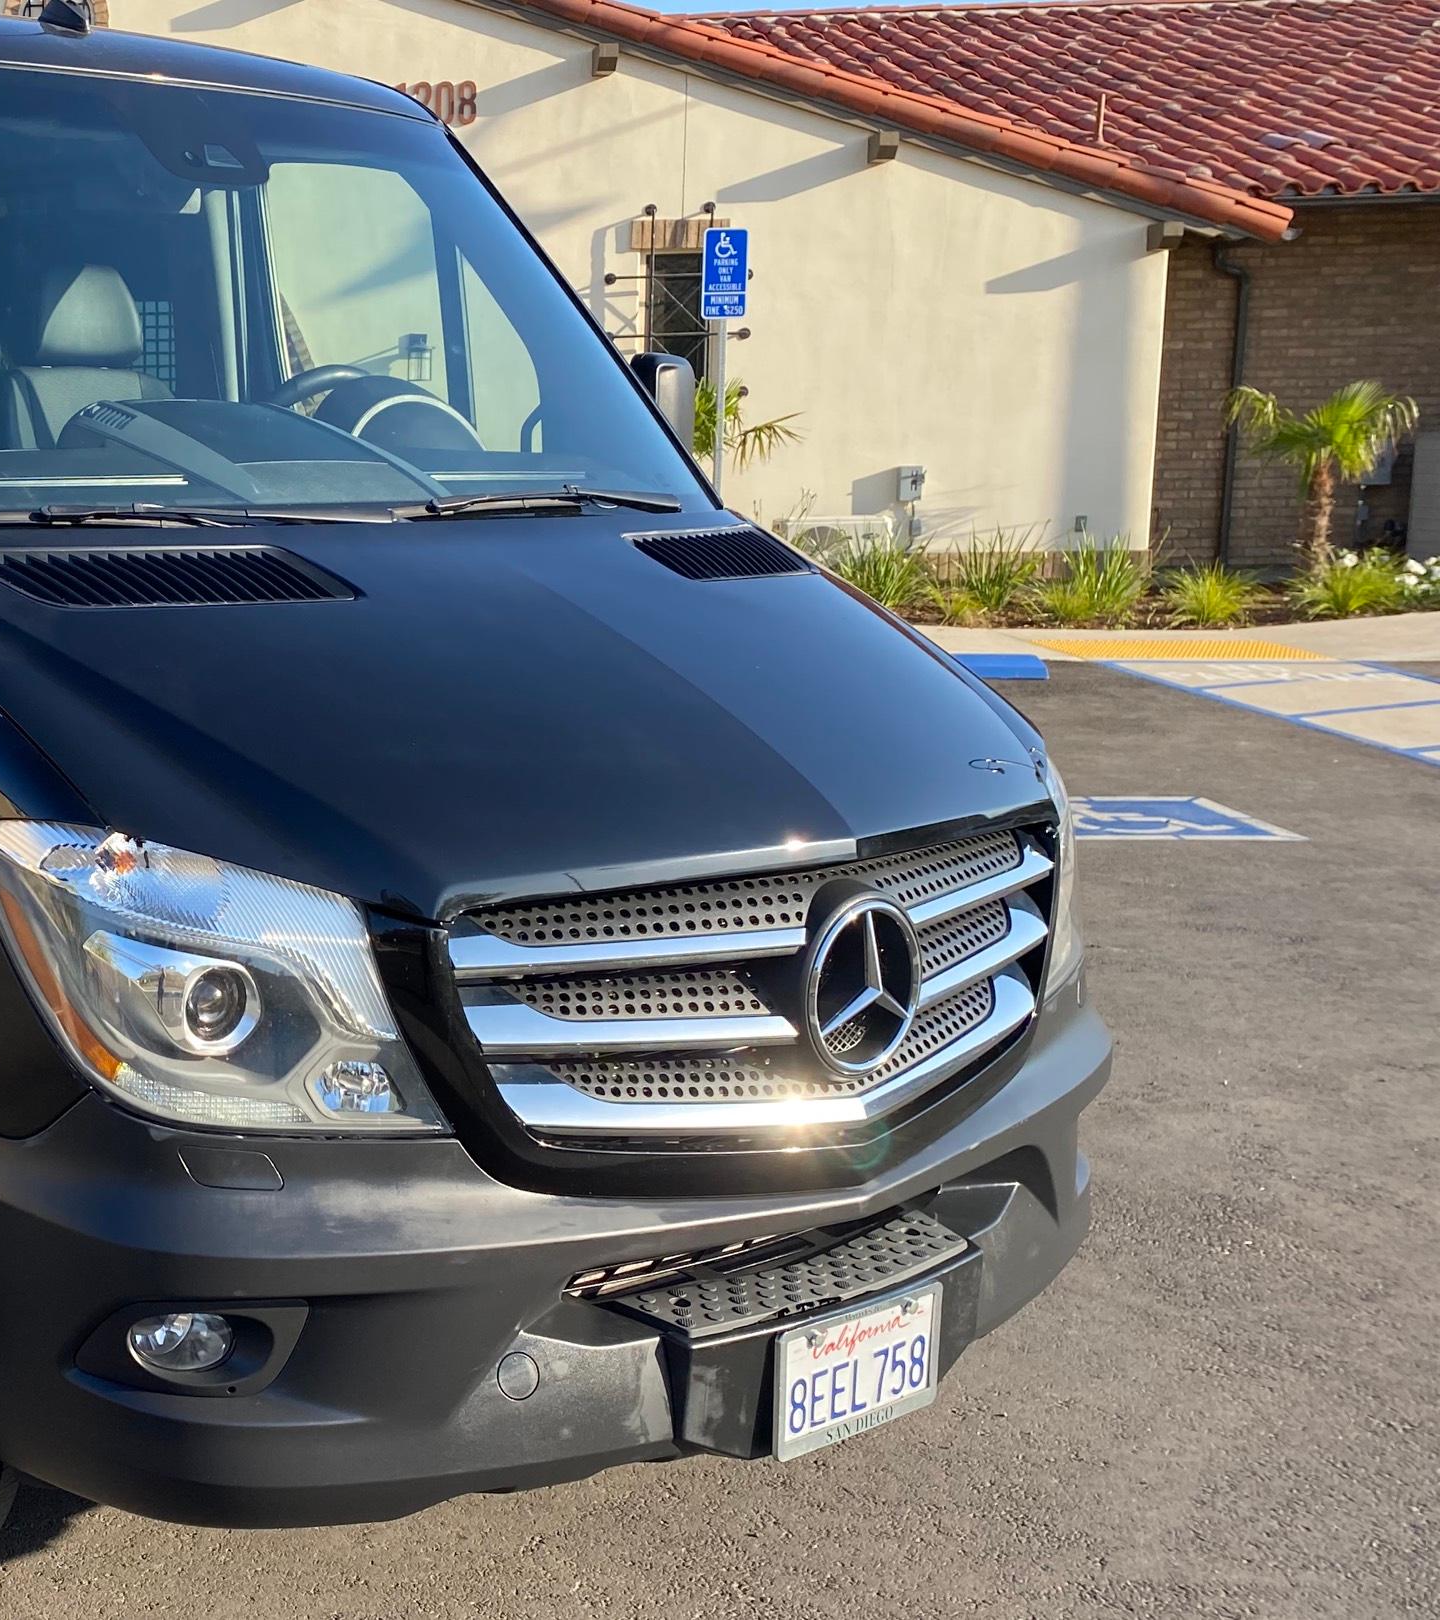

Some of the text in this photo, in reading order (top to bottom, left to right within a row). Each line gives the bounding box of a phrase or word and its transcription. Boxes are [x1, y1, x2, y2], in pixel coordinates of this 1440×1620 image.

[394, 81, 477, 125] 208
[714, 258, 738, 266] PARKING
[718, 266, 733, 274] ONLY
[709, 283, 742, 291] ACCESSIBLE
[711, 296, 738, 304] MINIMUM
[706, 306, 720, 315] FINE
[825, 1406, 893, 1443] SAN DIEGO
